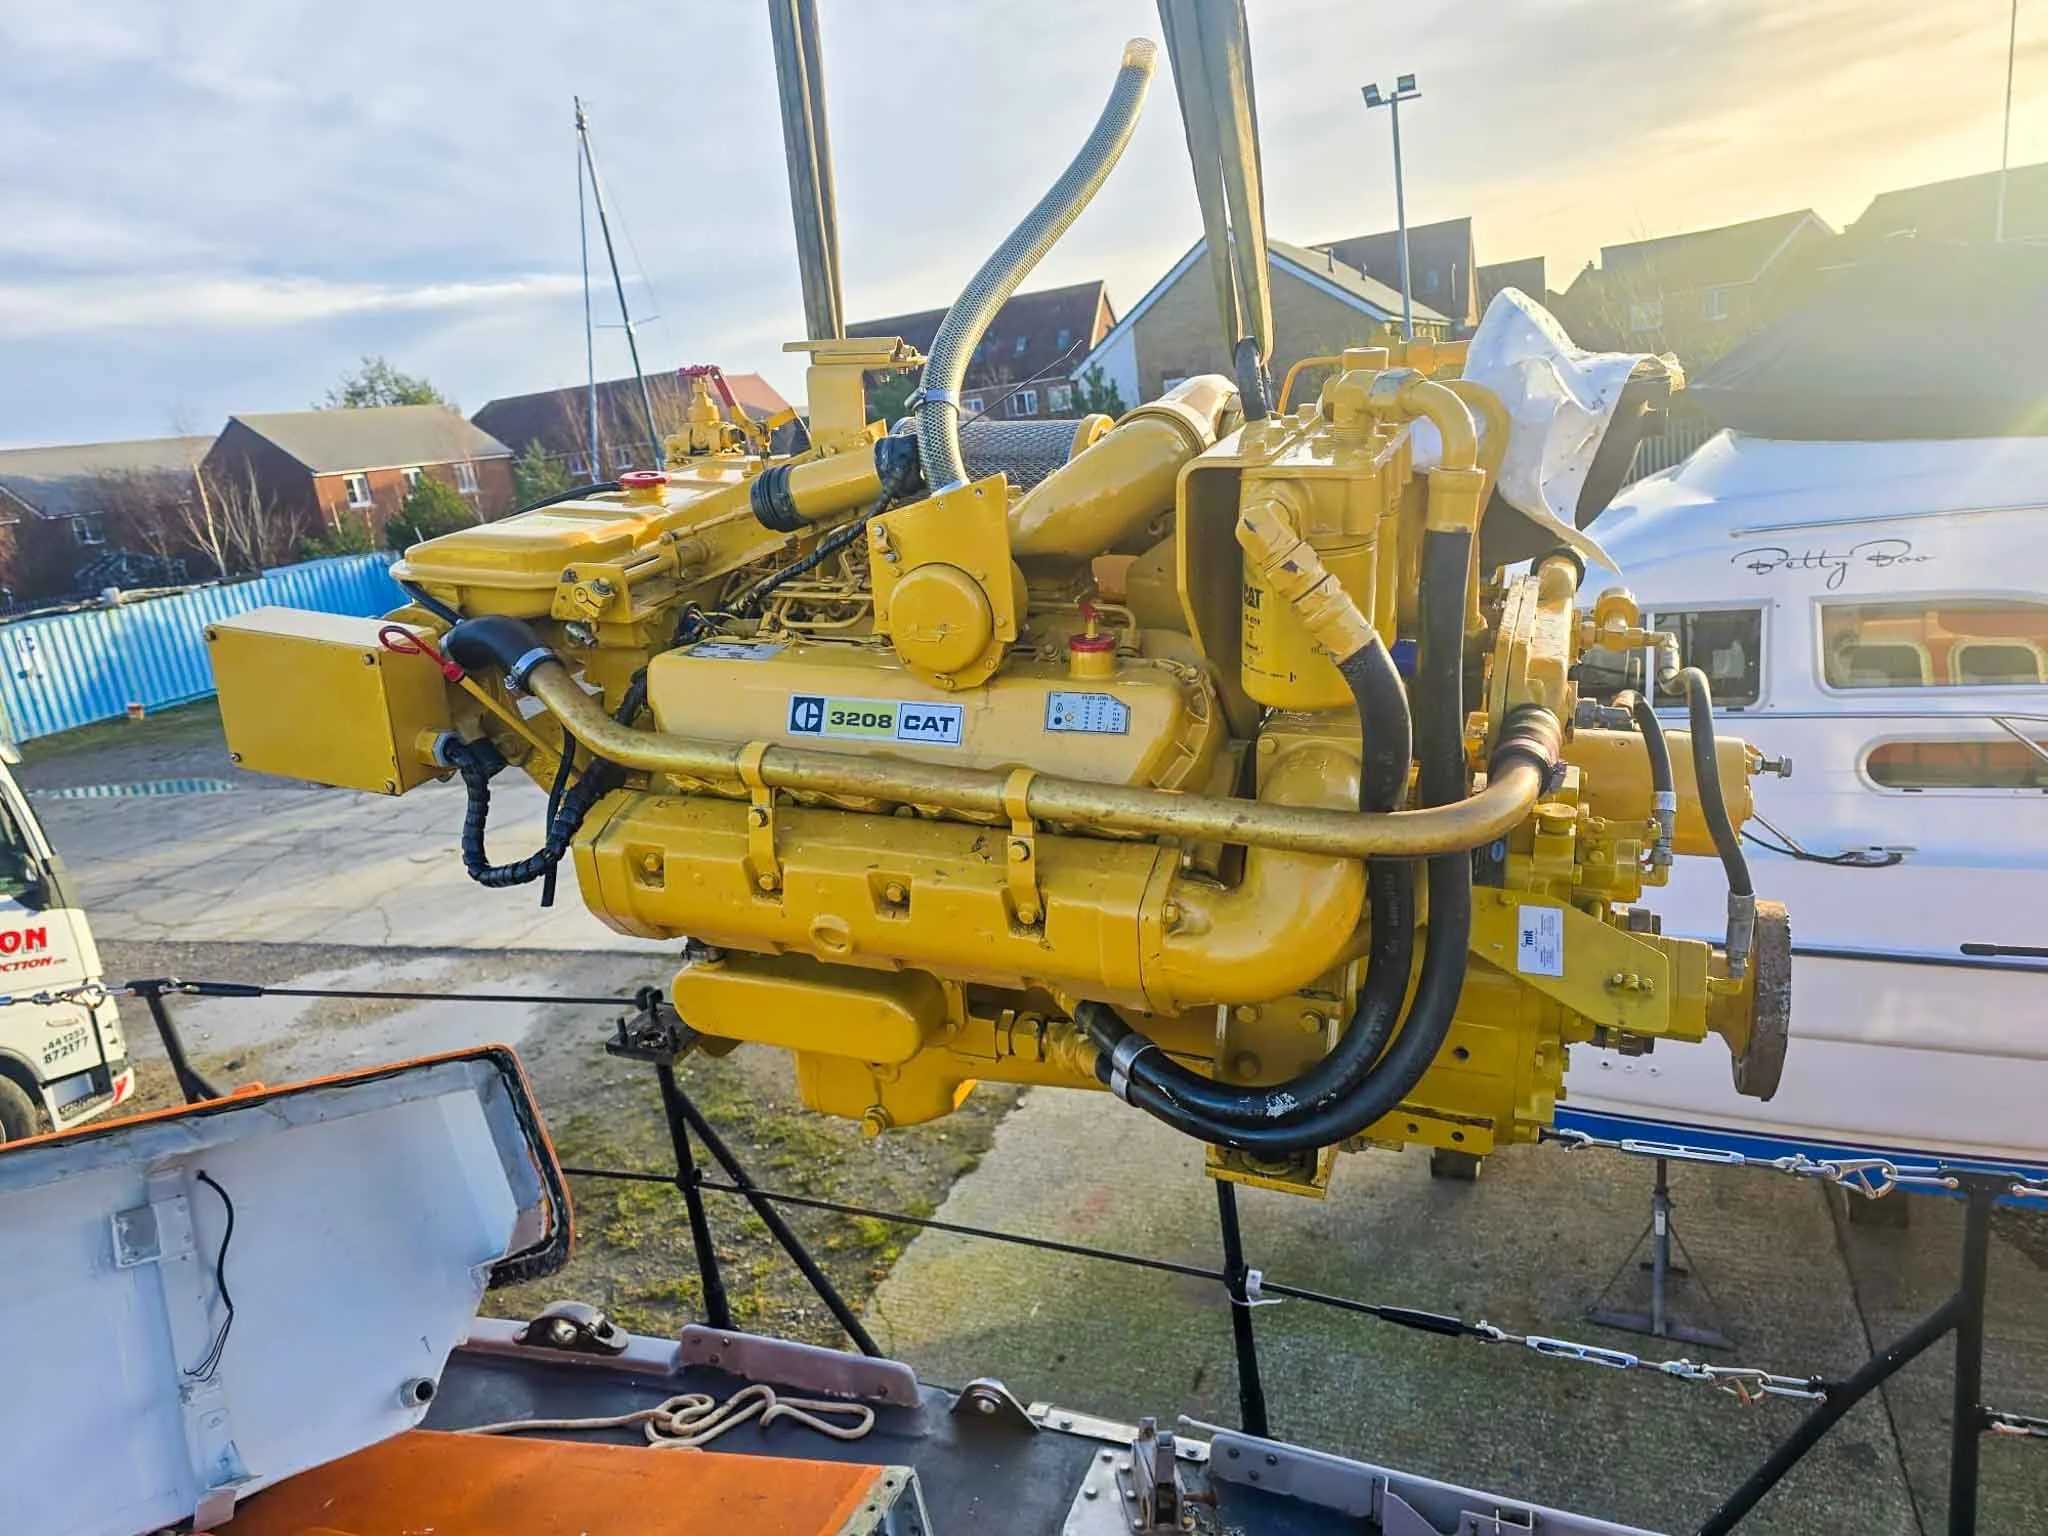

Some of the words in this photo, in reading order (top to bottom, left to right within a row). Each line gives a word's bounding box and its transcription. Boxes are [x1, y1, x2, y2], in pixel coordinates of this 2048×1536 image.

[1731, 547, 1853, 590] Betty
[1850, 539, 1936, 568] Boo
[1243, 583, 1264, 609] CAT
[830, 711, 893, 729] 3208
[903, 715, 955, 733] CAT
[0, 927, 48, 953] ON
